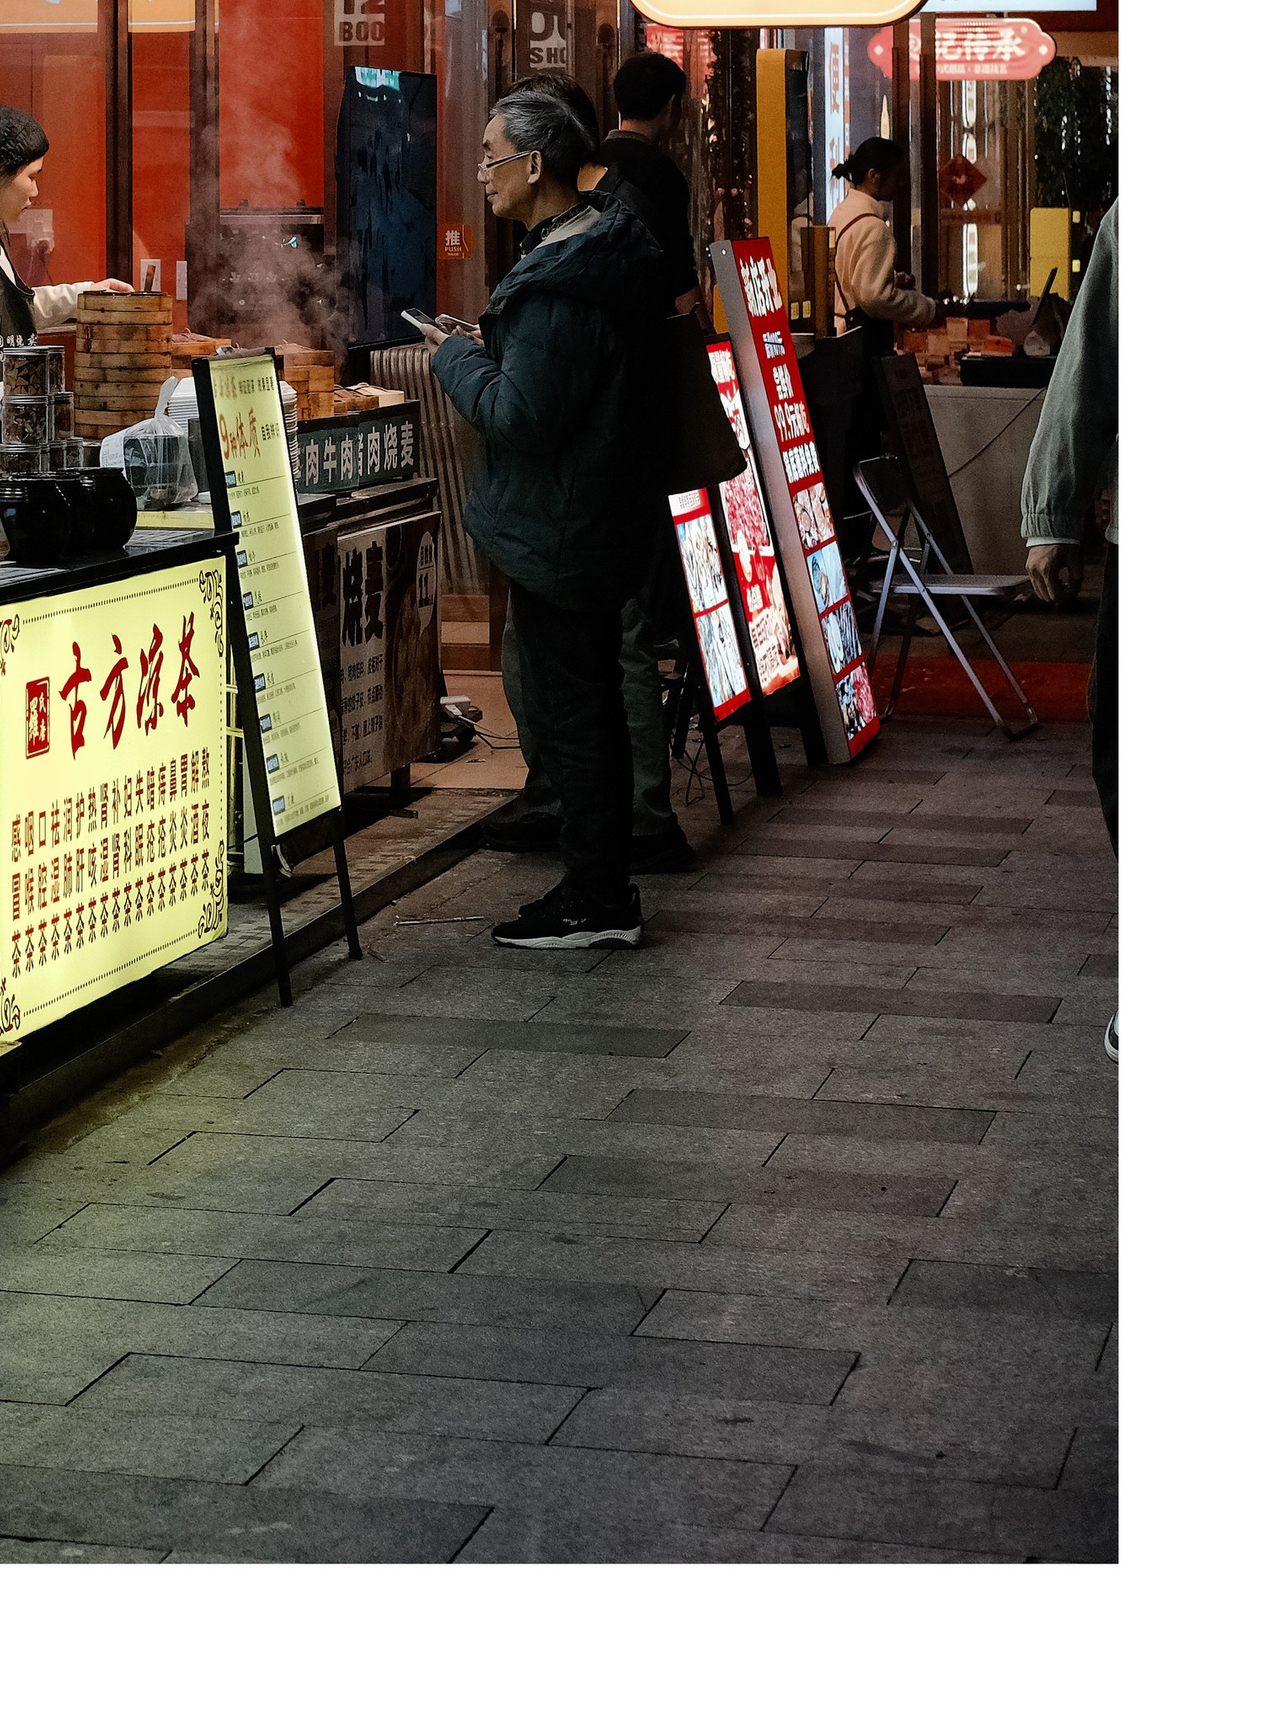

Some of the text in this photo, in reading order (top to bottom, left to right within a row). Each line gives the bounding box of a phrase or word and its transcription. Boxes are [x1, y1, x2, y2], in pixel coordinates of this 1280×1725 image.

[445, 230, 461, 246] 推
[58, 611, 200, 760] 古方凉茶
